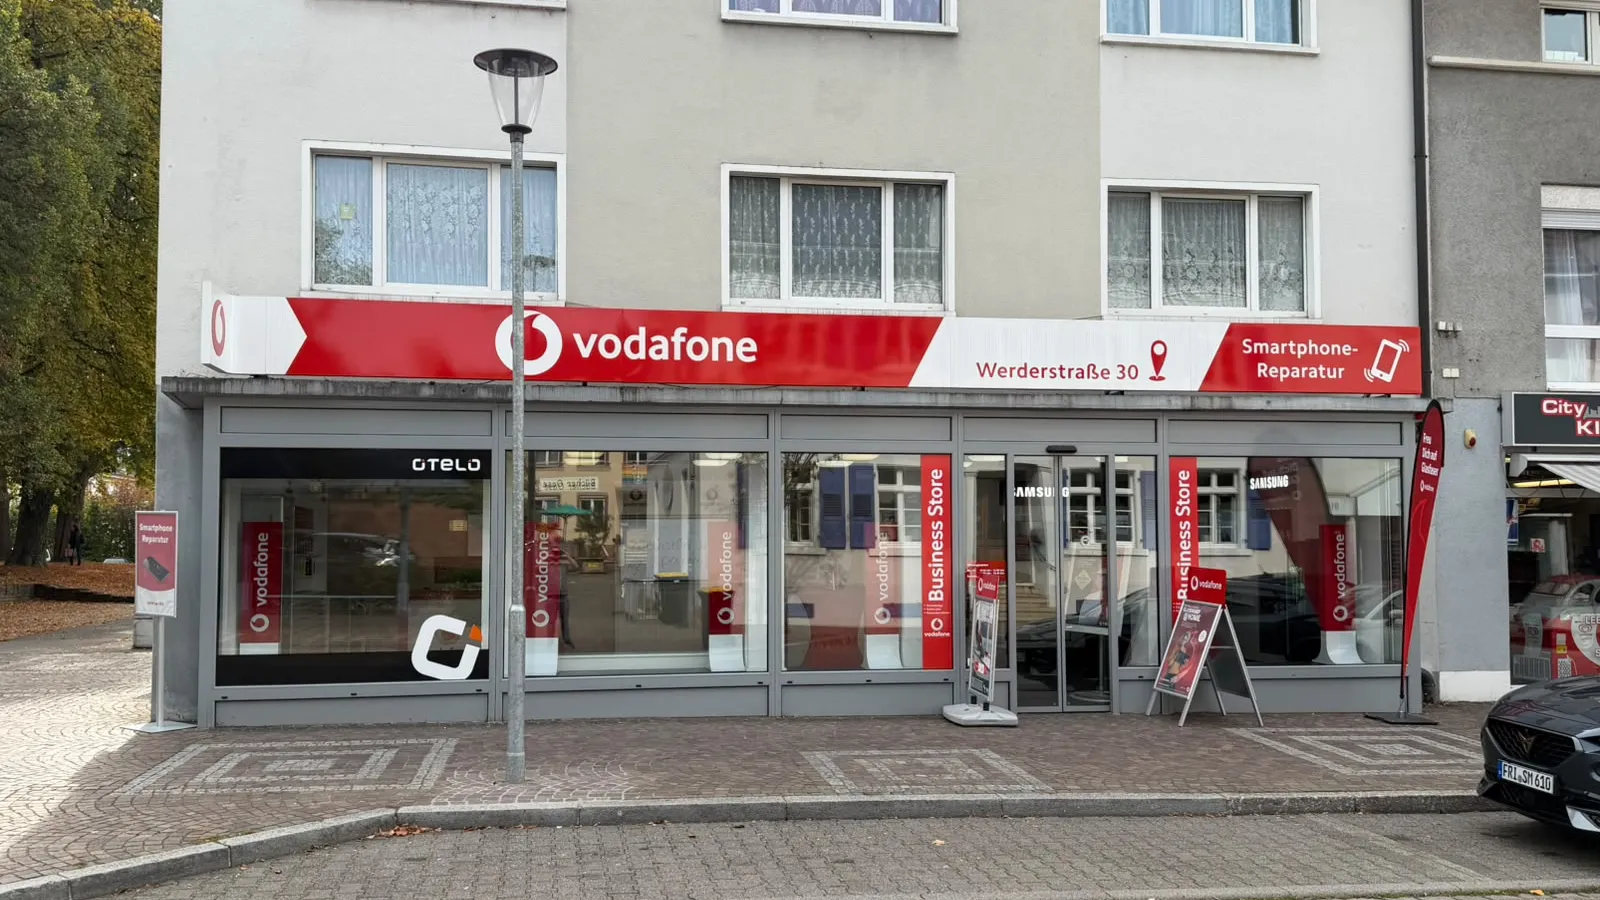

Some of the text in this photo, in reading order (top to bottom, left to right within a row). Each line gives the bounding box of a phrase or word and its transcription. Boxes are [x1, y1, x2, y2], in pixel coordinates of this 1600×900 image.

[572, 326, 758, 363] vodafone
[1242, 338, 1358, 359] Smartphone-
[976, 362, 1139, 380] Werderstraße 30
[1257, 362, 1345, 382] Reparatur
[1541, 398, 1586, 418] City
[928, 469, 944, 517] Store
[1013, 486, 1070, 498] AMSUG
[1175, 469, 1191, 517] Store
[1249, 474, 1289, 491] SAMSUNG
[139, 523, 174, 533] Smartphone
[142, 534, 169, 545] Reparatur
[253, 532, 269, 607] vodafone
[536, 531, 550, 603] vodafone
[720, 531, 732, 601] vodafone
[876, 532, 889, 602] vodafone
[928, 520, 945, 602] Business
[1334, 533, 1346, 600] vodafone
[1199, 580, 1222, 590] vodafone
[1503, 763, 1551, 791] FRI SM 610
